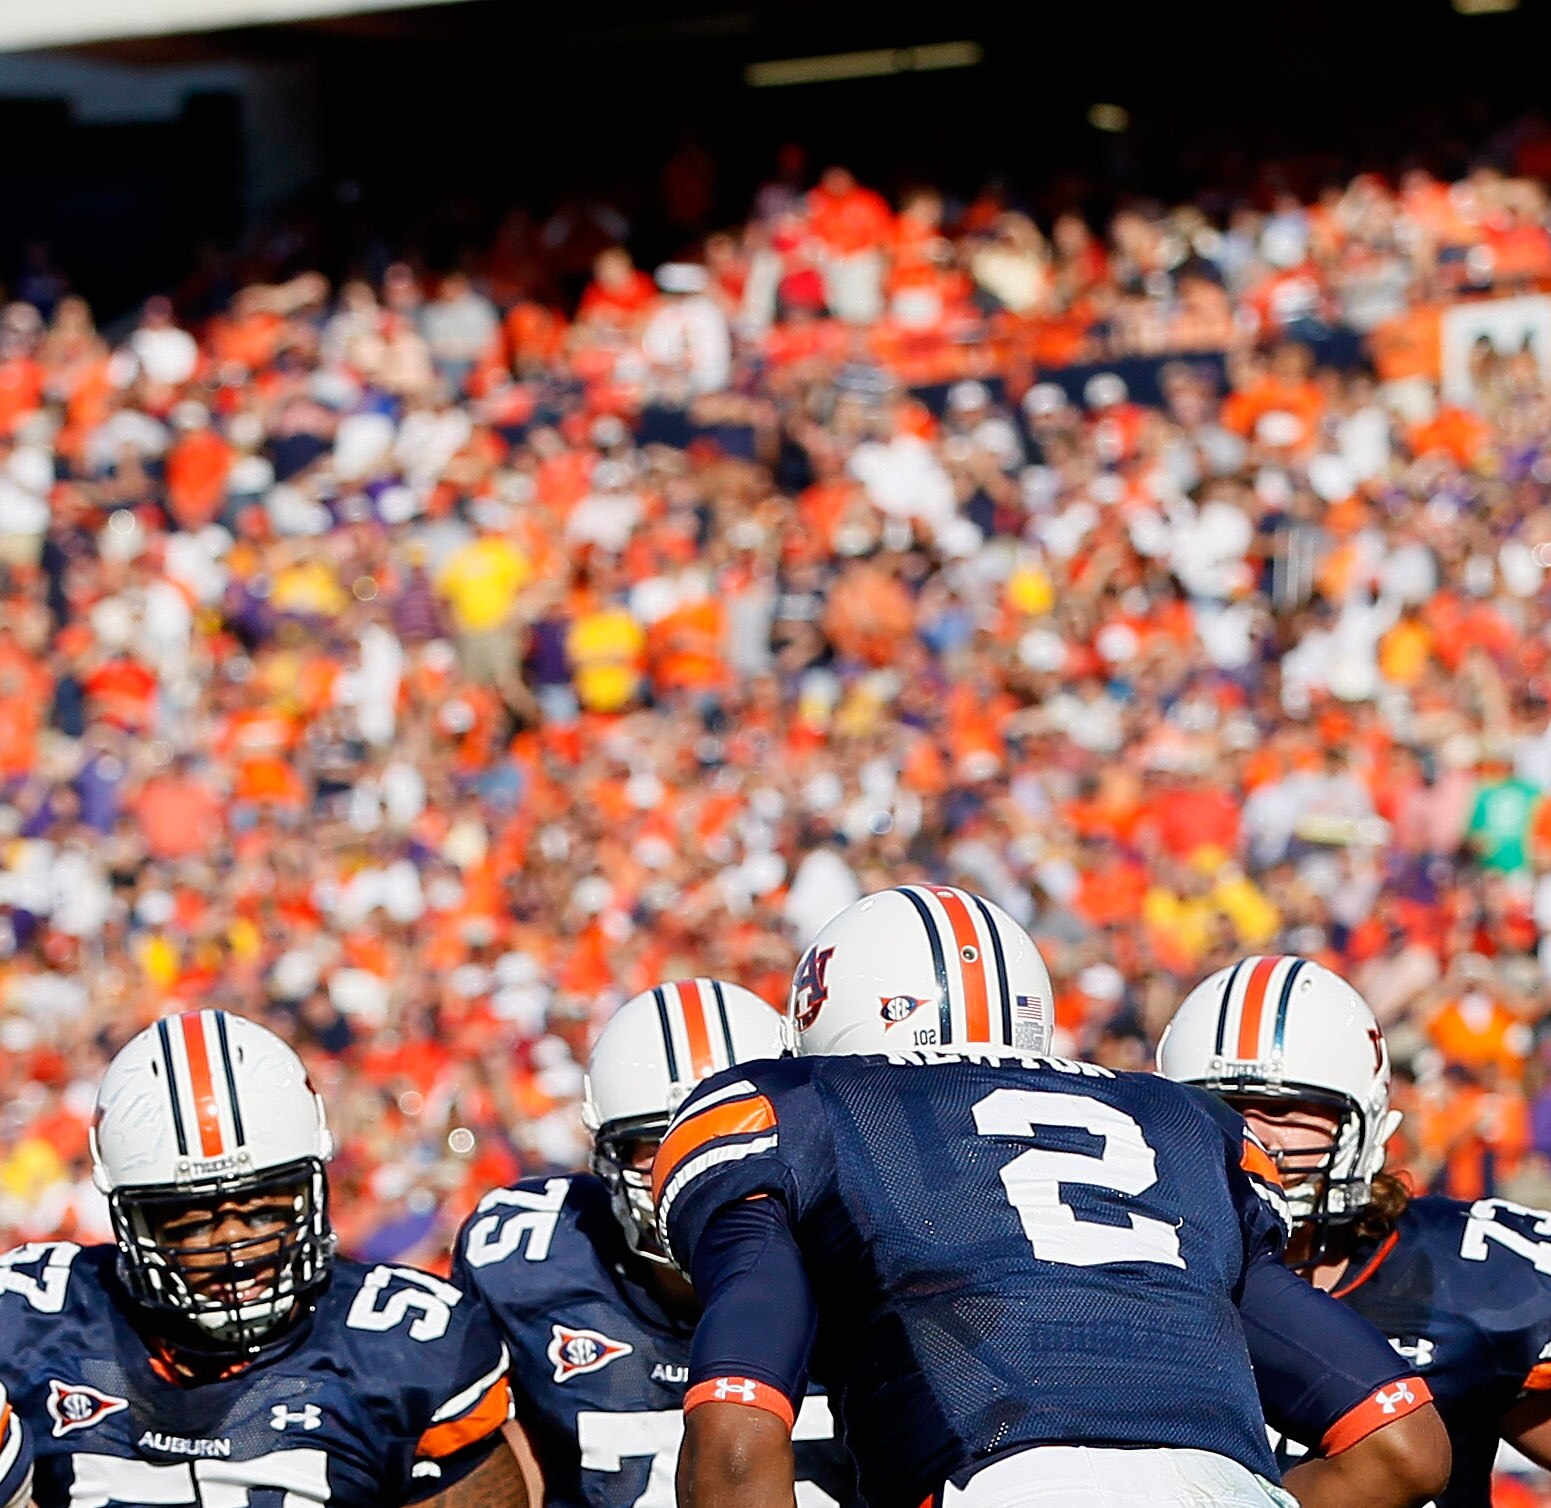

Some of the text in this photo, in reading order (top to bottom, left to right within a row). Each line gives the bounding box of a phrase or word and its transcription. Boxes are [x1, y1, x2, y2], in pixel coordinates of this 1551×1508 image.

[913, 1029, 937, 1046] 102
[971, 1088, 1187, 1270] 2
[466, 1178, 570, 1268] 75
[346, 1265, 464, 1342] 57
[138, 1430, 231, 1457] AUBURN
